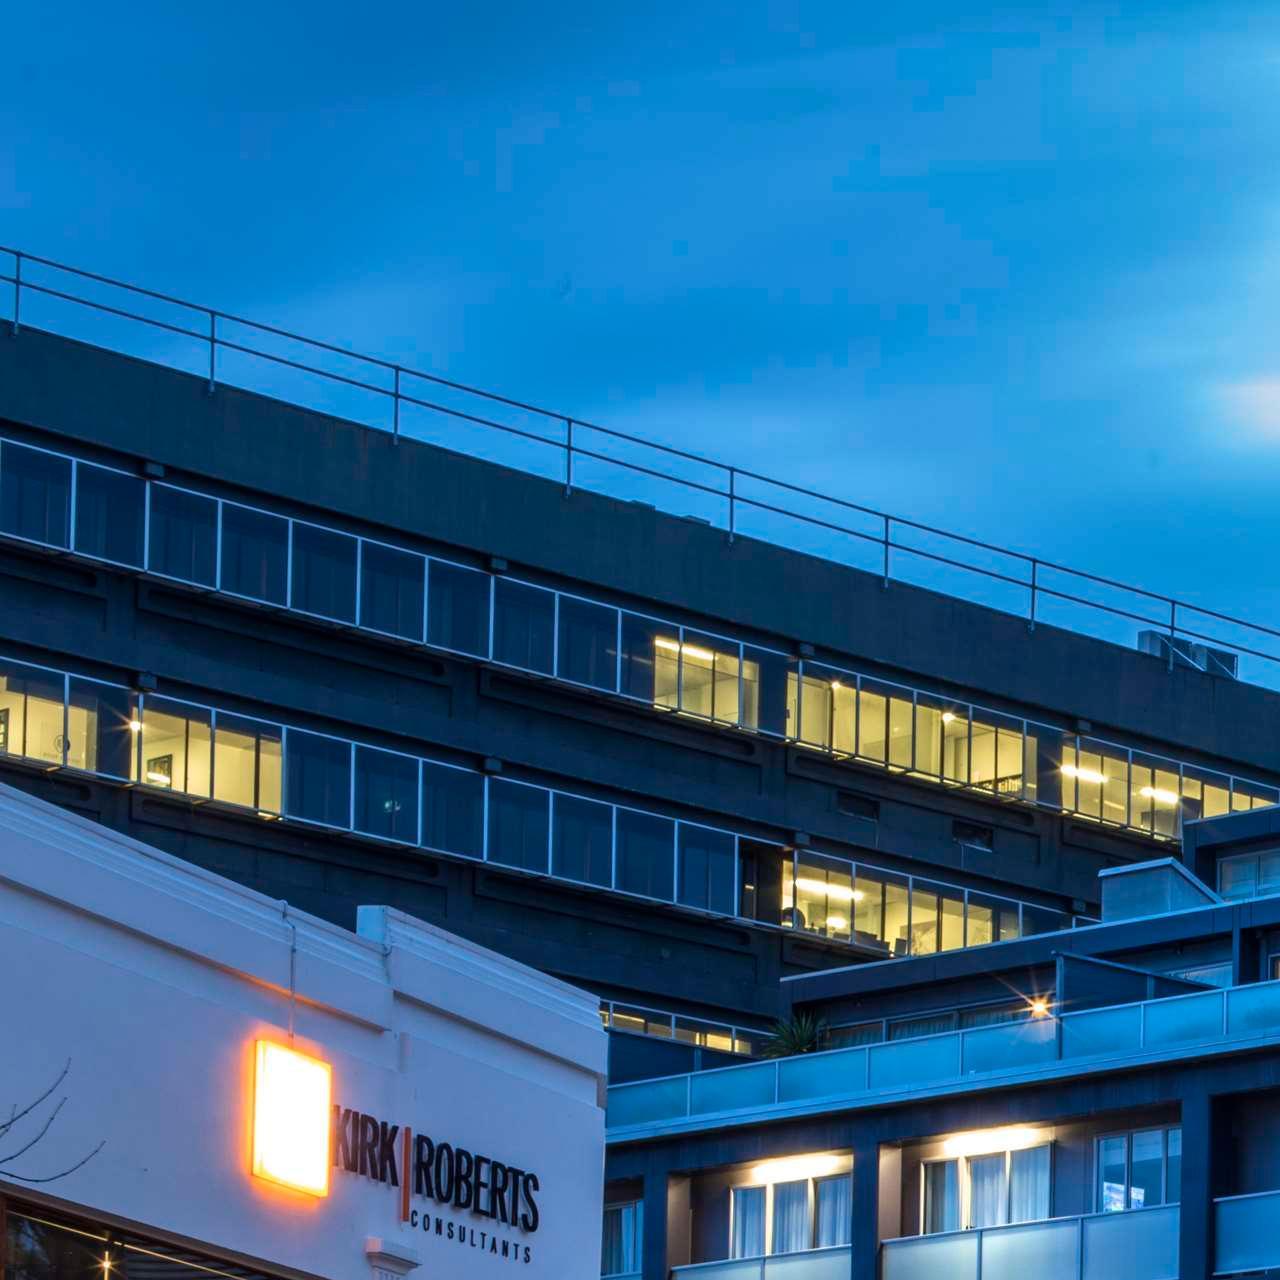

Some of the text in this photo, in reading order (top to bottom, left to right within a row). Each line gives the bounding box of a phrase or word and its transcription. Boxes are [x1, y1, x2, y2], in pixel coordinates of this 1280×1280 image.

[331, 1104, 539, 1233] KIRK ROBERTS
[411, 1210, 531, 1264] CONSULTANTS
